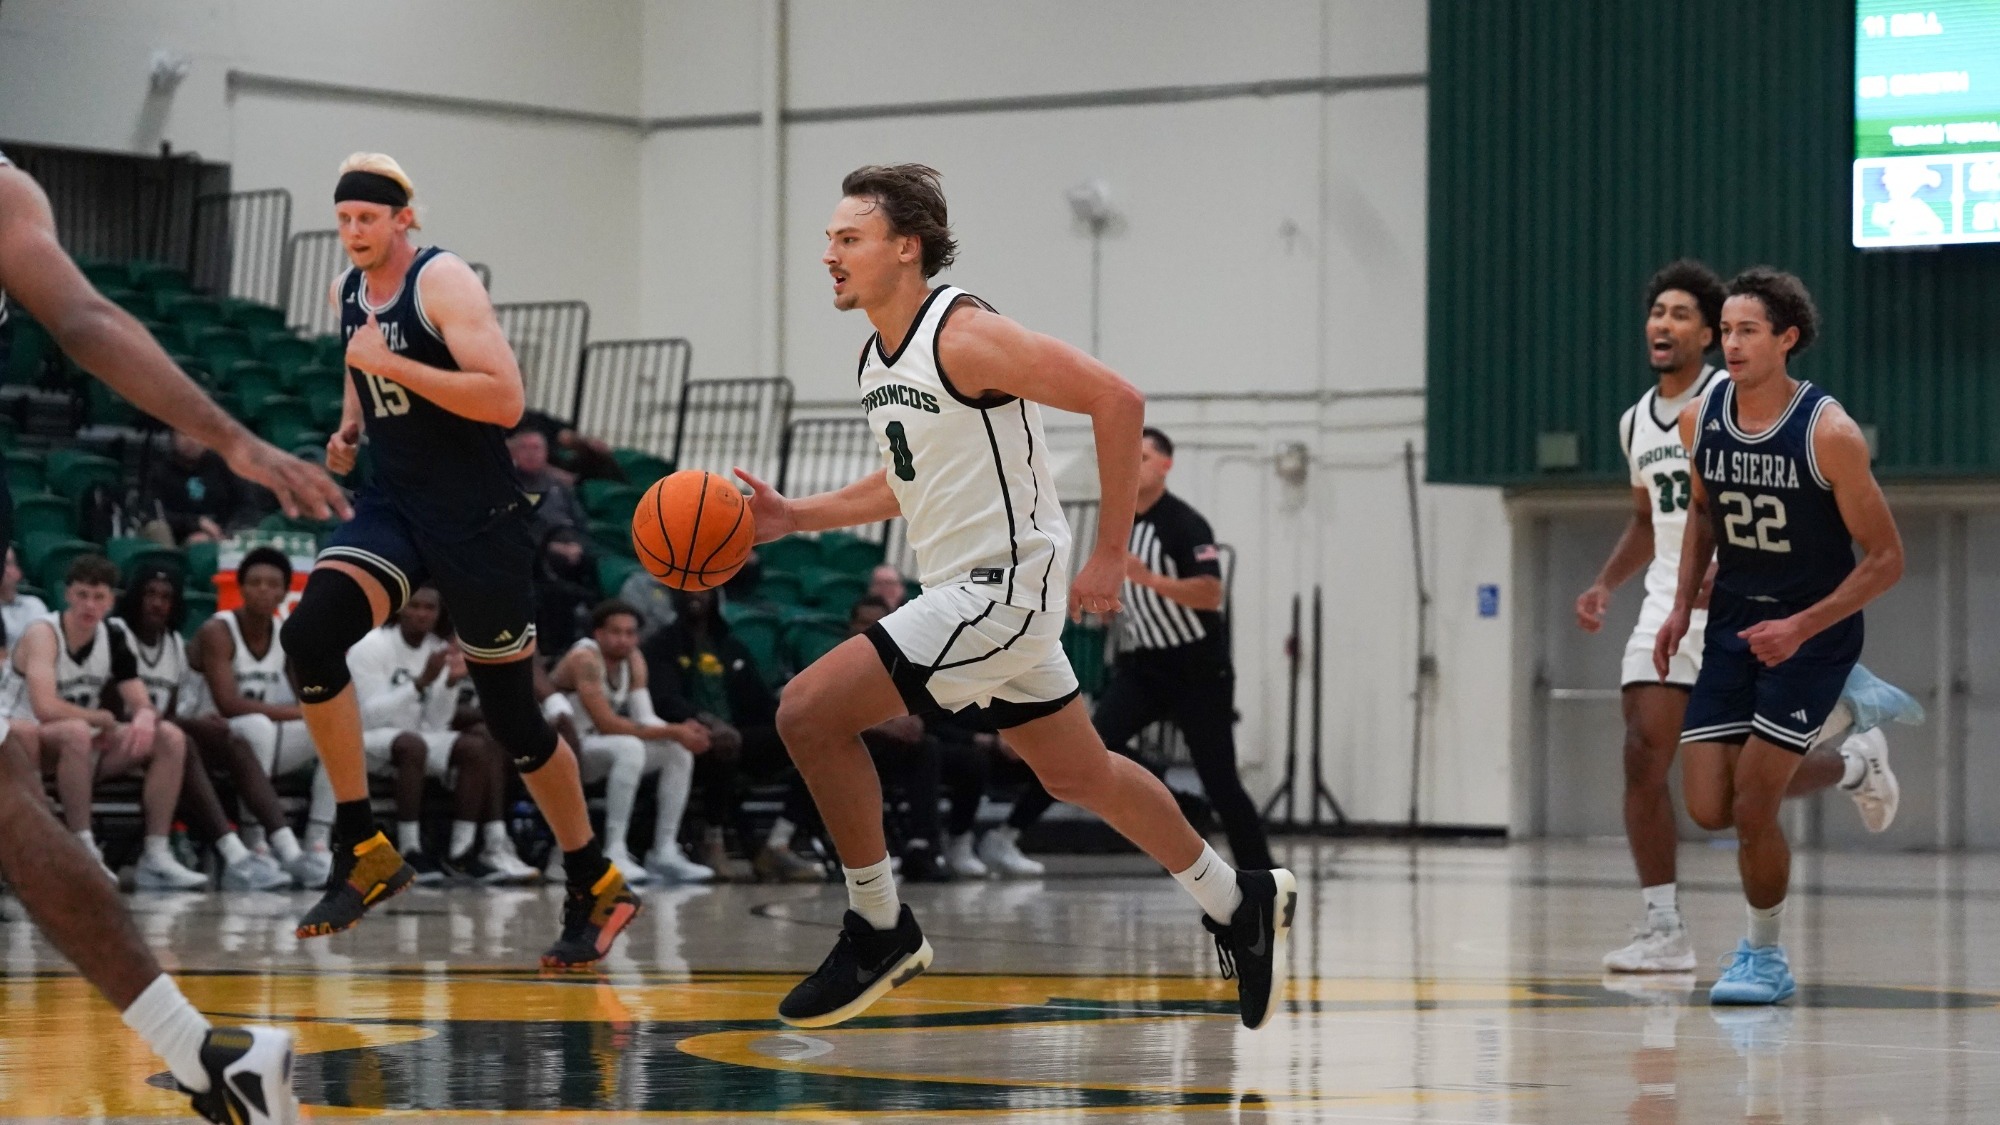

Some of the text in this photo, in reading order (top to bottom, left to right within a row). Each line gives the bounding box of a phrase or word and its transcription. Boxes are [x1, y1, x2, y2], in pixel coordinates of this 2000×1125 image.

[362, 370, 411, 418] 15
[885, 421, 916, 481] 0
[1704, 448, 1800, 489] LA SIERRA
[1653, 470, 1692, 513] 33
[1718, 491, 1792, 552] 22
